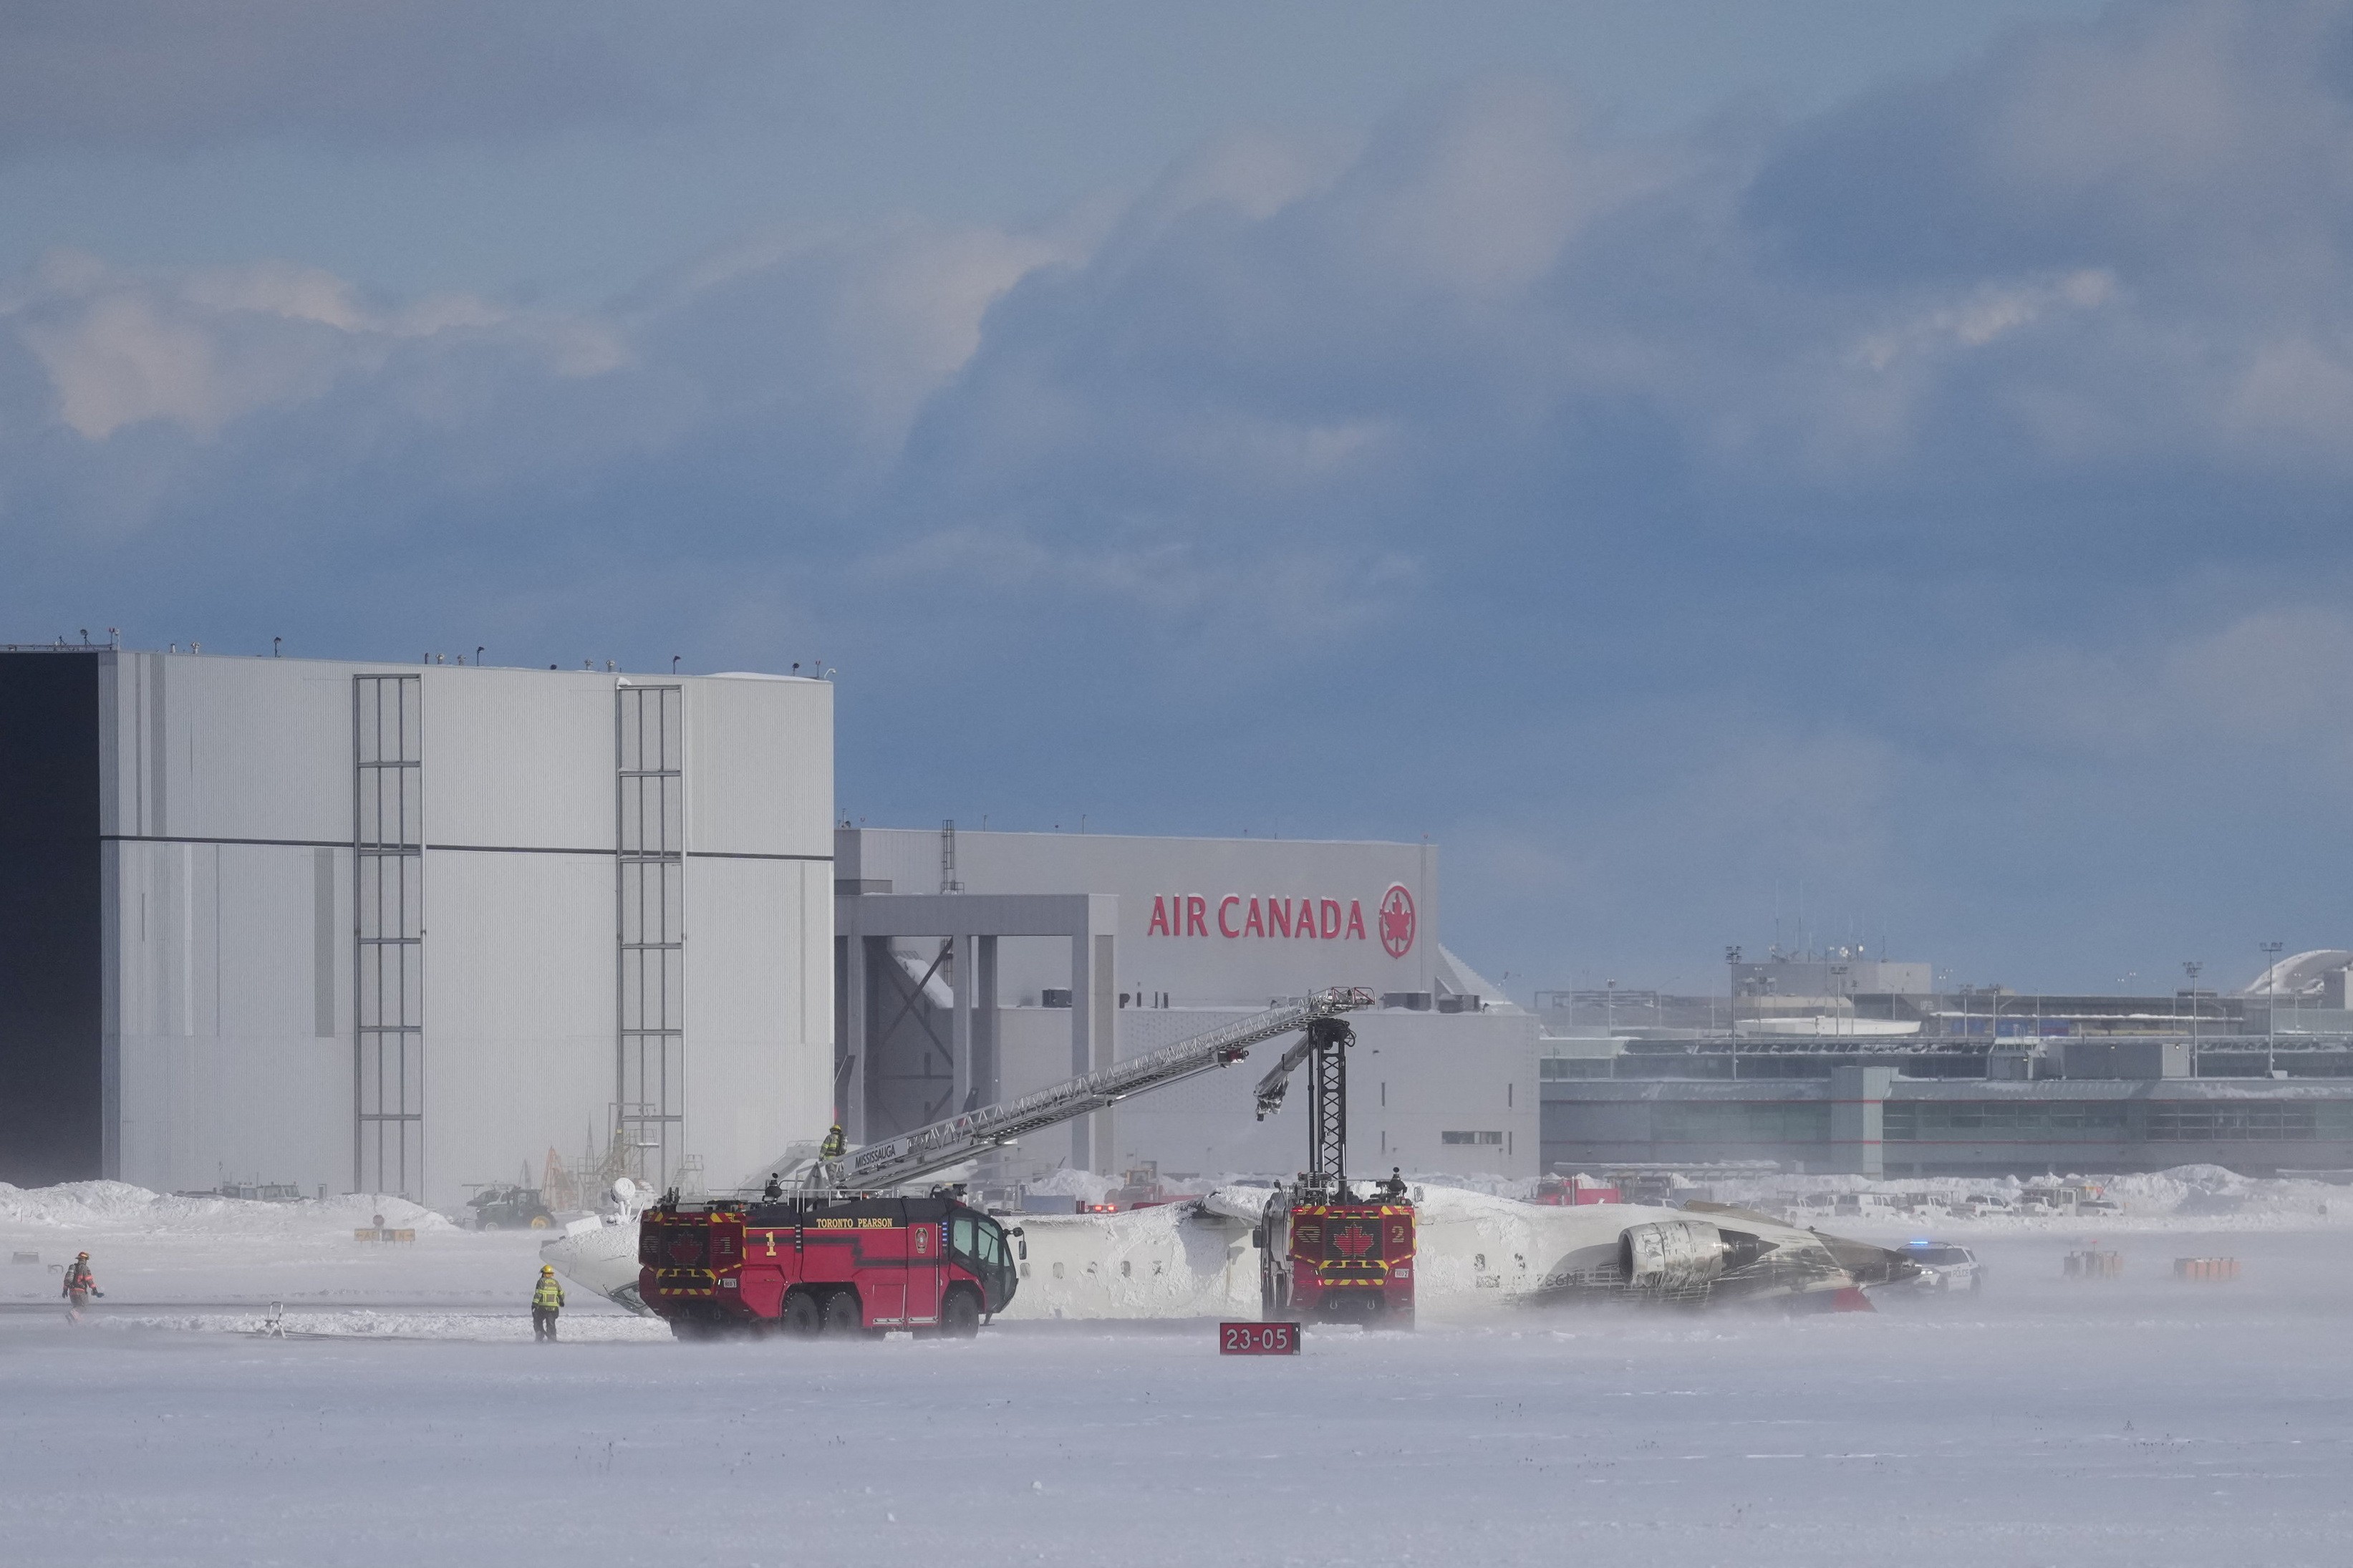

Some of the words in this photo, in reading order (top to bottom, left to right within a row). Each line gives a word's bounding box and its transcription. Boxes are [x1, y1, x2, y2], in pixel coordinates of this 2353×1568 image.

[1148, 894, 1209, 937] AIR
[1219, 894, 1366, 940] CANADA
[856, 1146, 895, 1169] MISSISSAUGA
[816, 1219, 854, 1228] TORONTO
[858, 1219, 893, 1228] PEARSON
[765, 1231, 776, 1257] 1
[1391, 1226, 1404, 1243] 2
[1953, 1269, 1968, 1278] POLICE
[1227, 1329, 1287, 1350] 23-05
